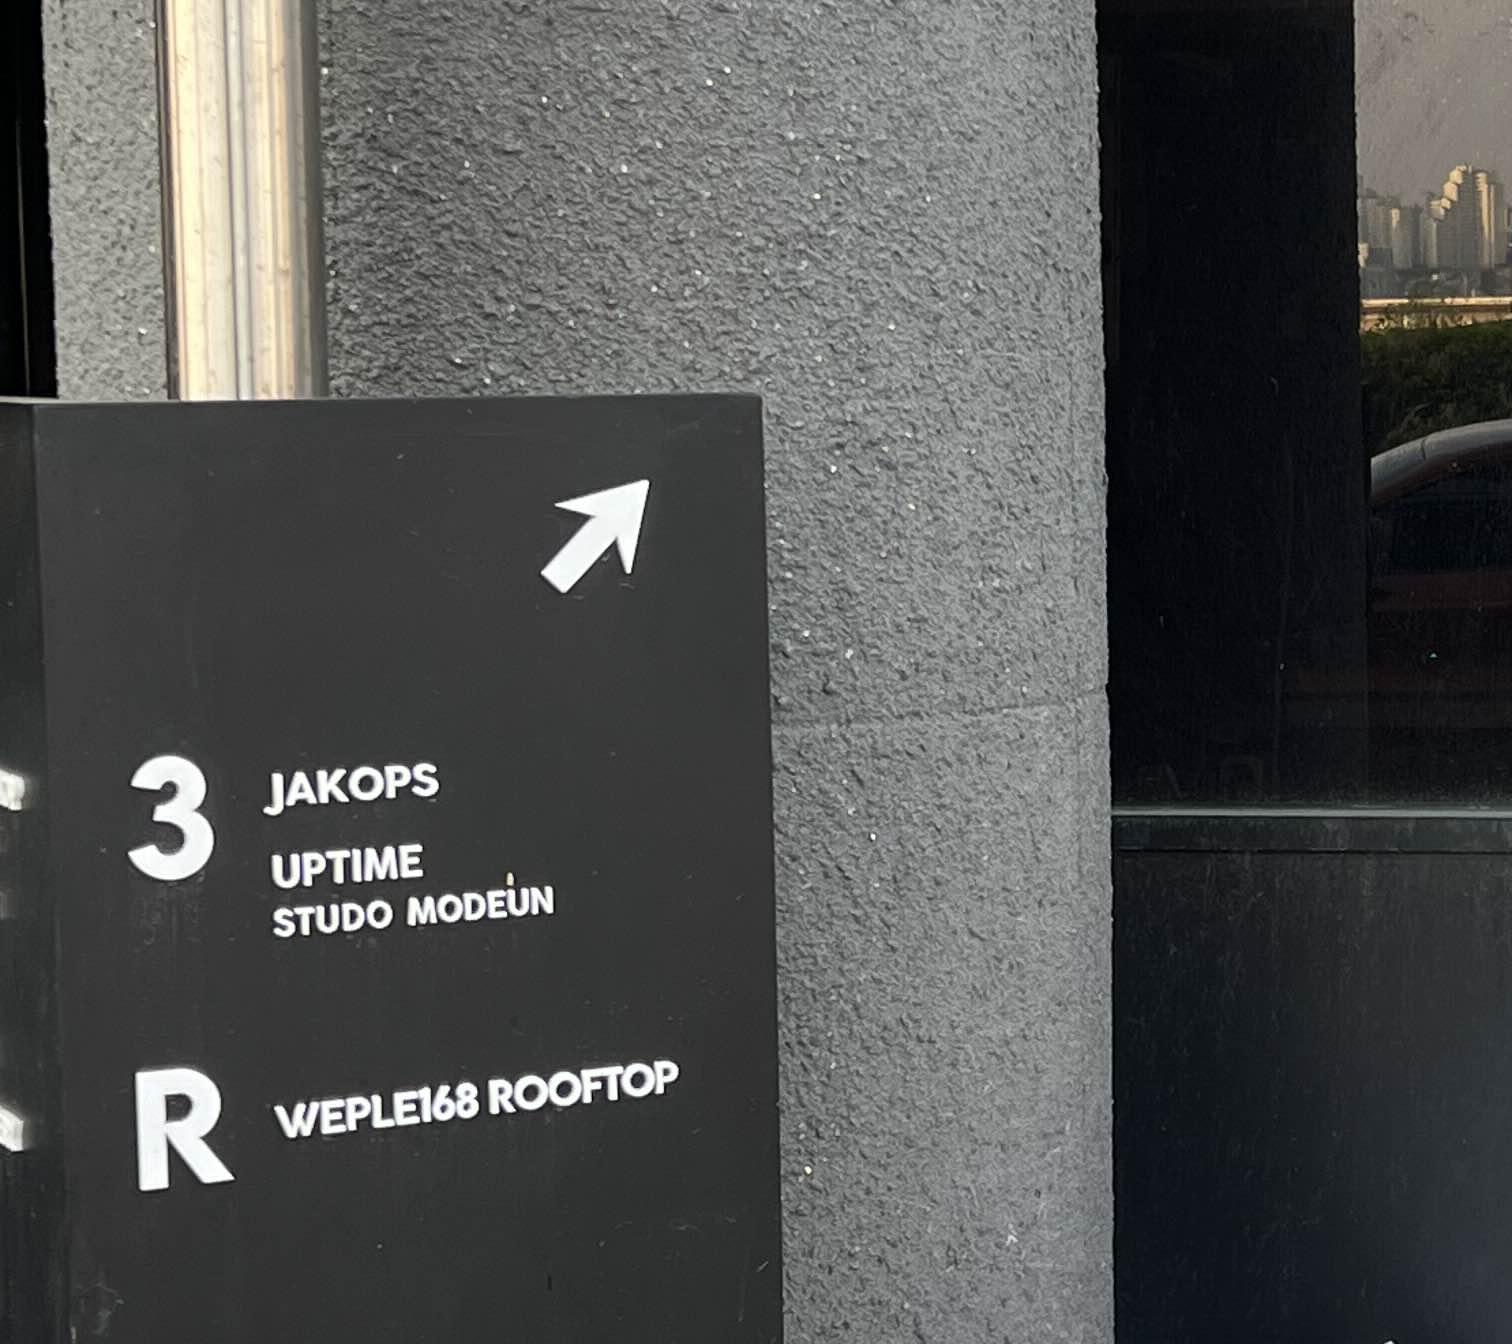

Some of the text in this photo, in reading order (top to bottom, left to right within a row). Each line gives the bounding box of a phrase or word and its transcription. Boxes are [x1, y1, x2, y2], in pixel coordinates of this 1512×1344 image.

[127, 754, 215, 881] 3
[262, 762, 440, 816] JAKOPS
[271, 843, 424, 889] UPTIME
[134, 1067, 235, 1192] R
[273, 1060, 680, 1139] WEPLE168 ROOFTOP
